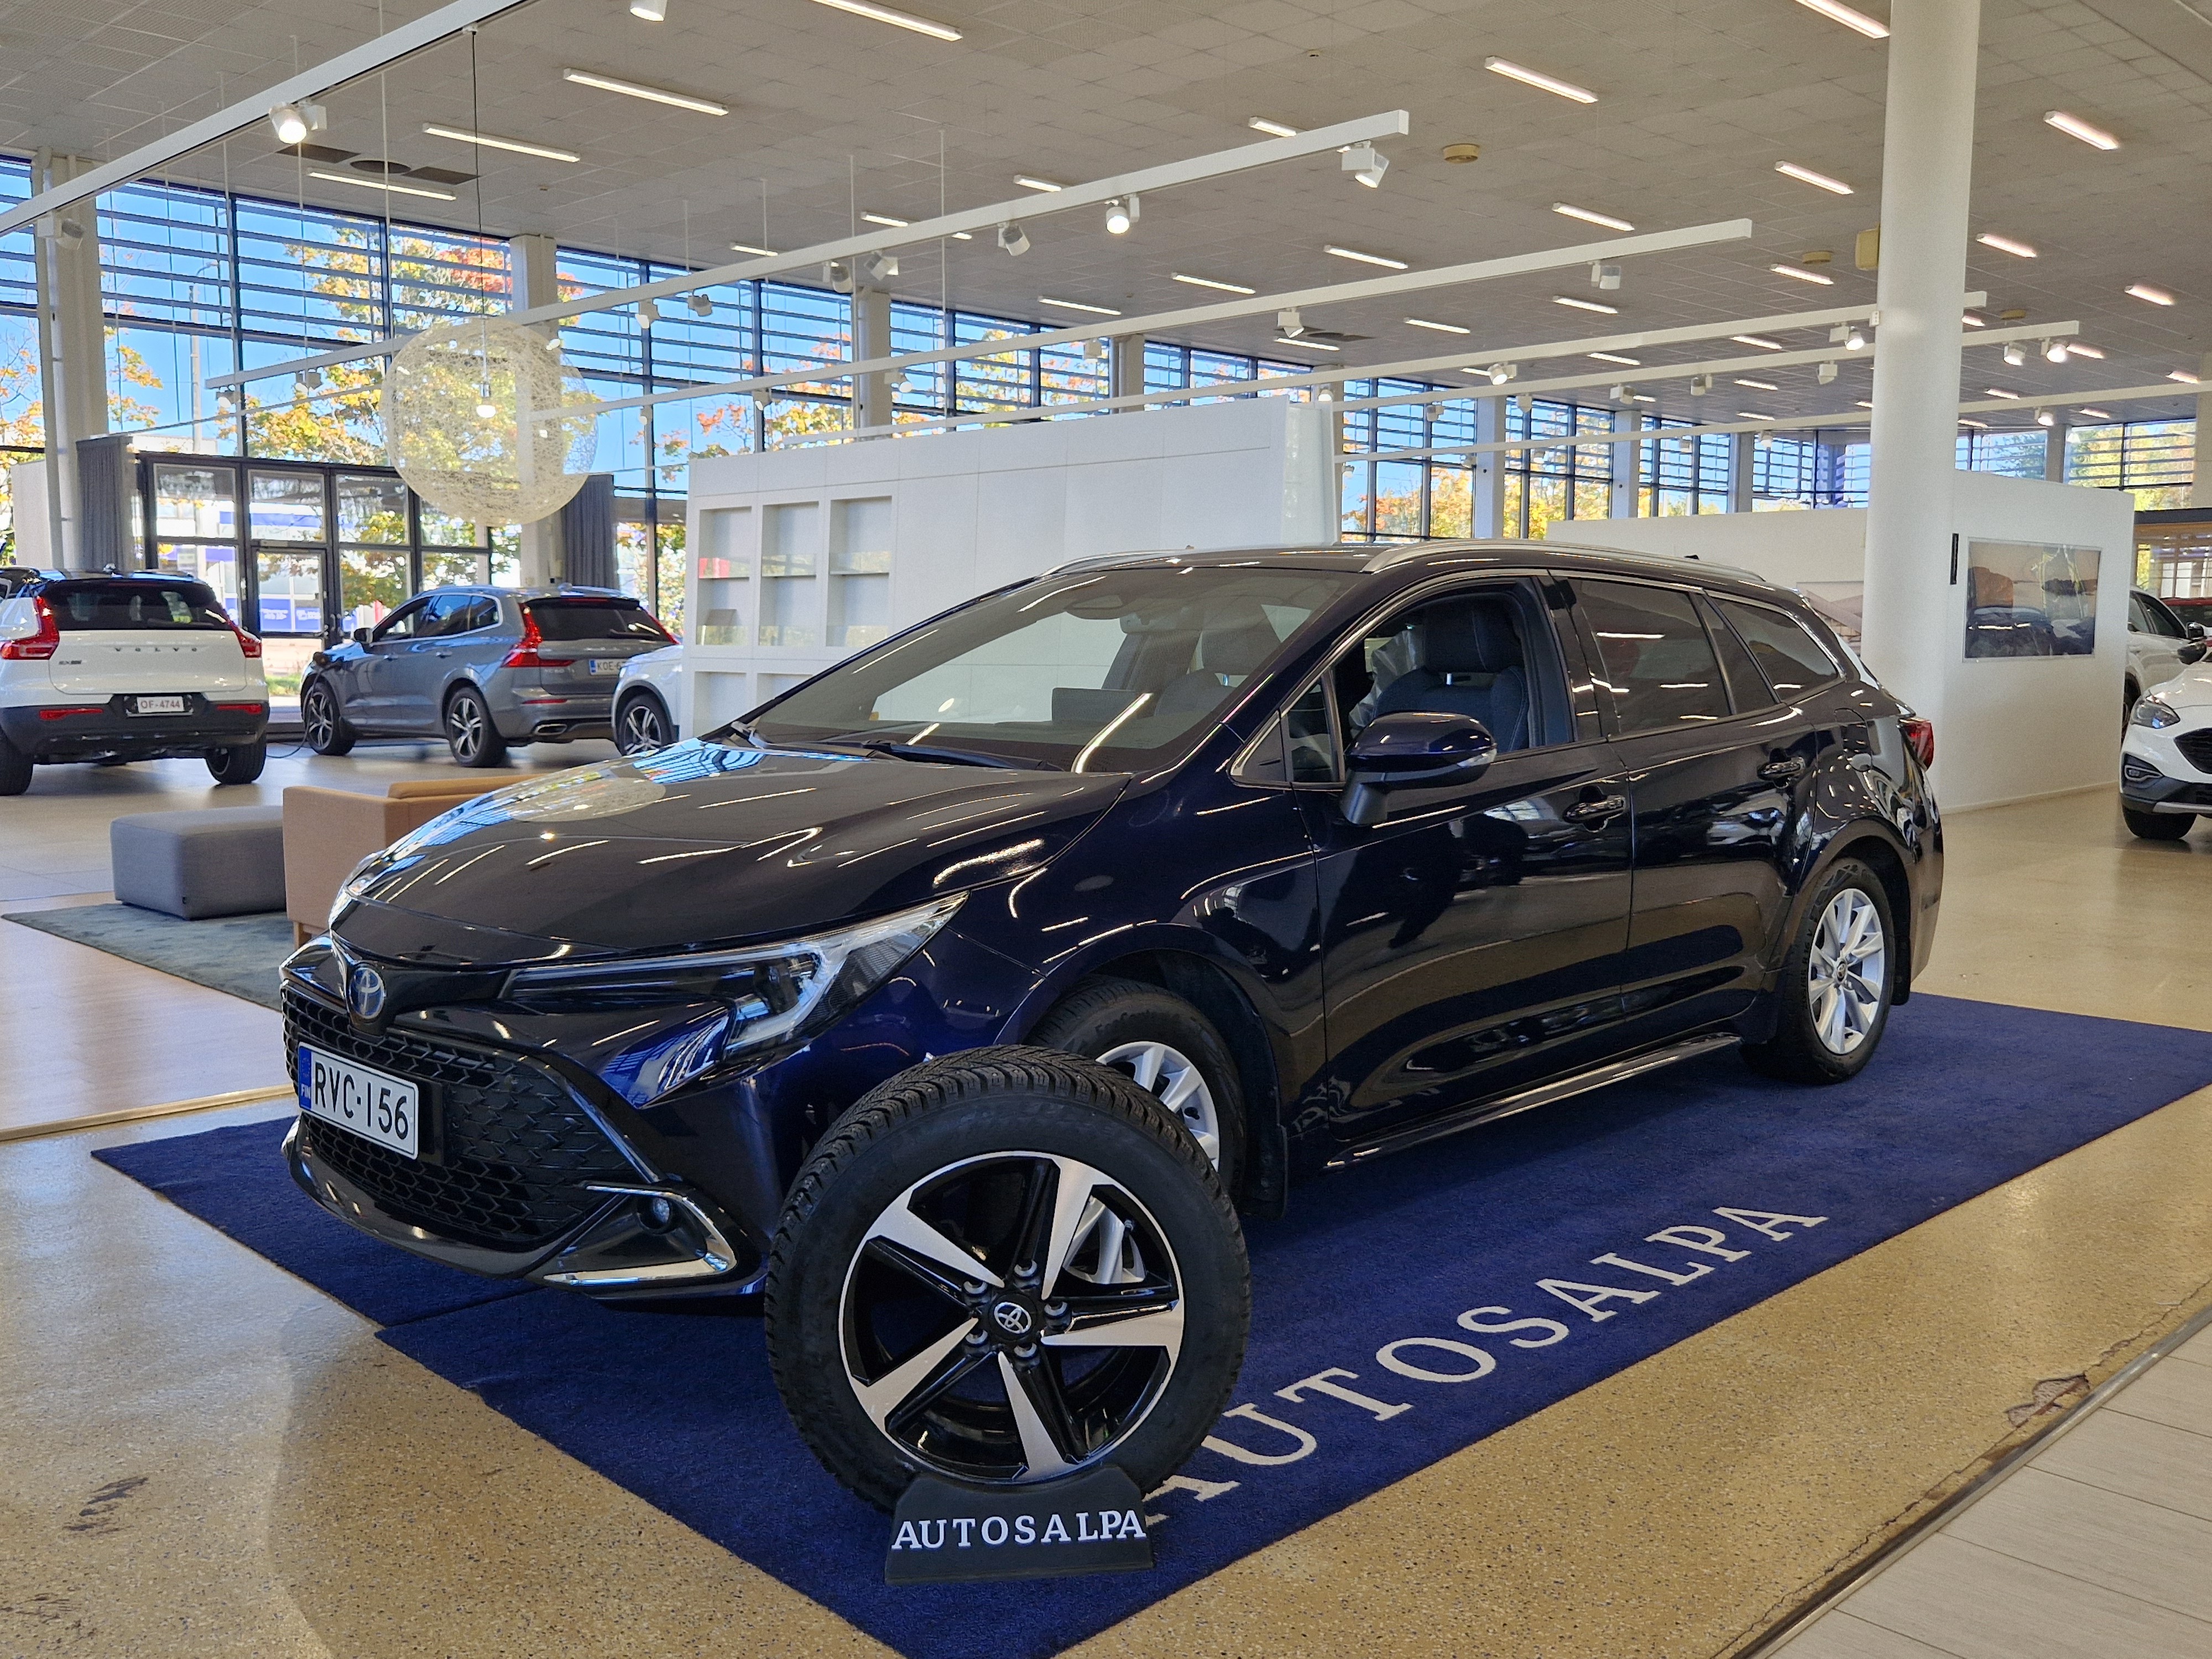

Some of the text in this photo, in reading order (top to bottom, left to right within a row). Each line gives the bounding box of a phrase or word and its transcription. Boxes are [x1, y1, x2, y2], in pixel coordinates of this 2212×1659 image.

[140, 700, 180, 709] OF-4744
[301, 1083, 311, 1100] FIN
[315, 1062, 409, 1140] RVC-156
[891, 1509, 1147, 1551] AUTOSALPA
